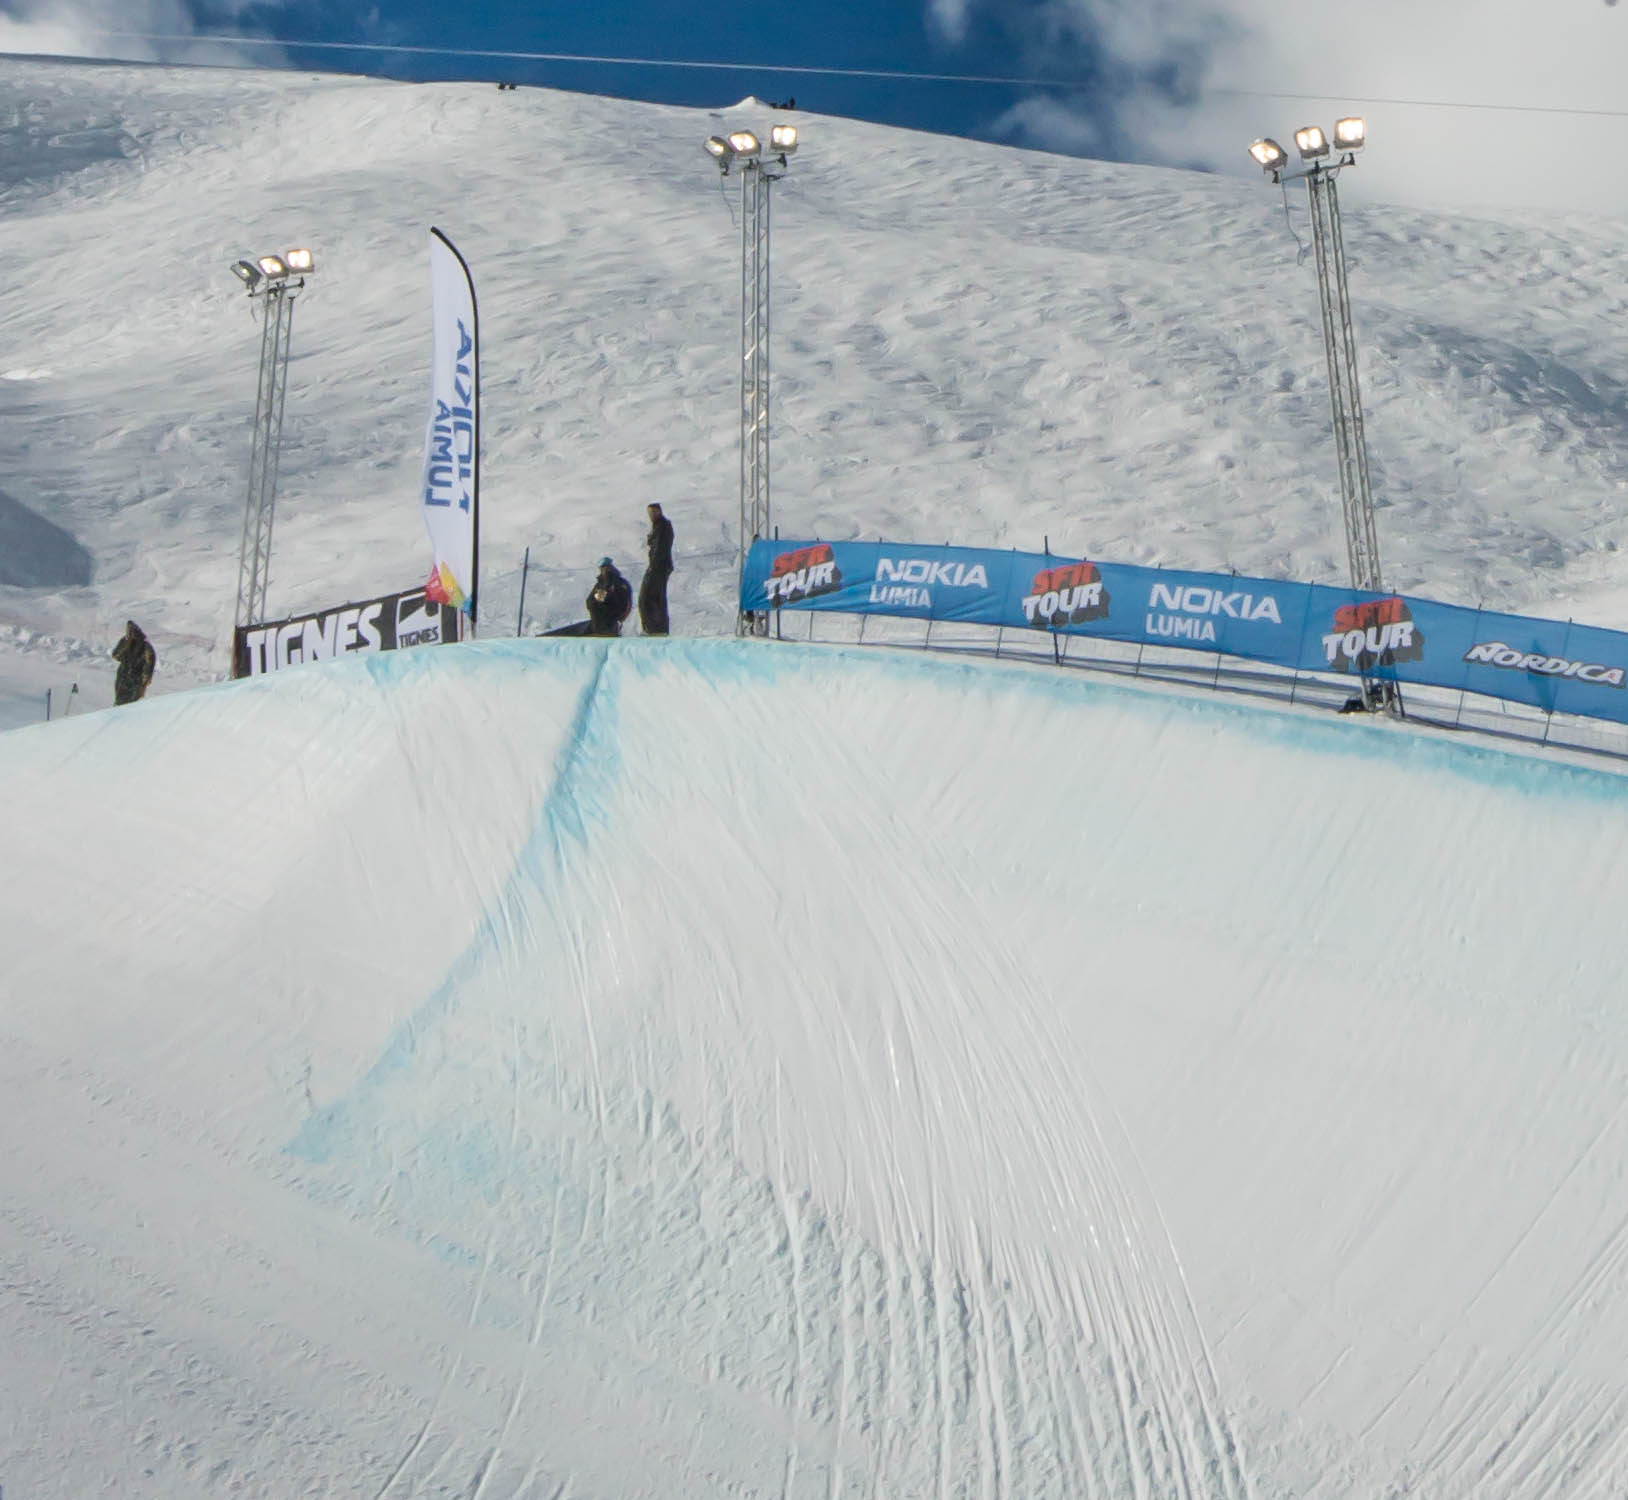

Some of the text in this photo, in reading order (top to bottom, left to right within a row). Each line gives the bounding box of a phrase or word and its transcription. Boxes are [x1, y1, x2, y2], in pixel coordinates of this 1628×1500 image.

[763, 560, 835, 600] TOUR
[876, 558, 988, 589] NOKIA
[869, 584, 932, 608] LUMIA
[1022, 582, 1103, 624] TOUR
[1150, 583, 1282, 624] NOKIA
[246, 602, 382, 678] TIGNES
[400, 626, 439, 649] TIGNES
[1146, 613, 1216, 642] LUMIA
[1322, 621, 1416, 664] TOUR
[1465, 642, 1625, 686] NORDICA
